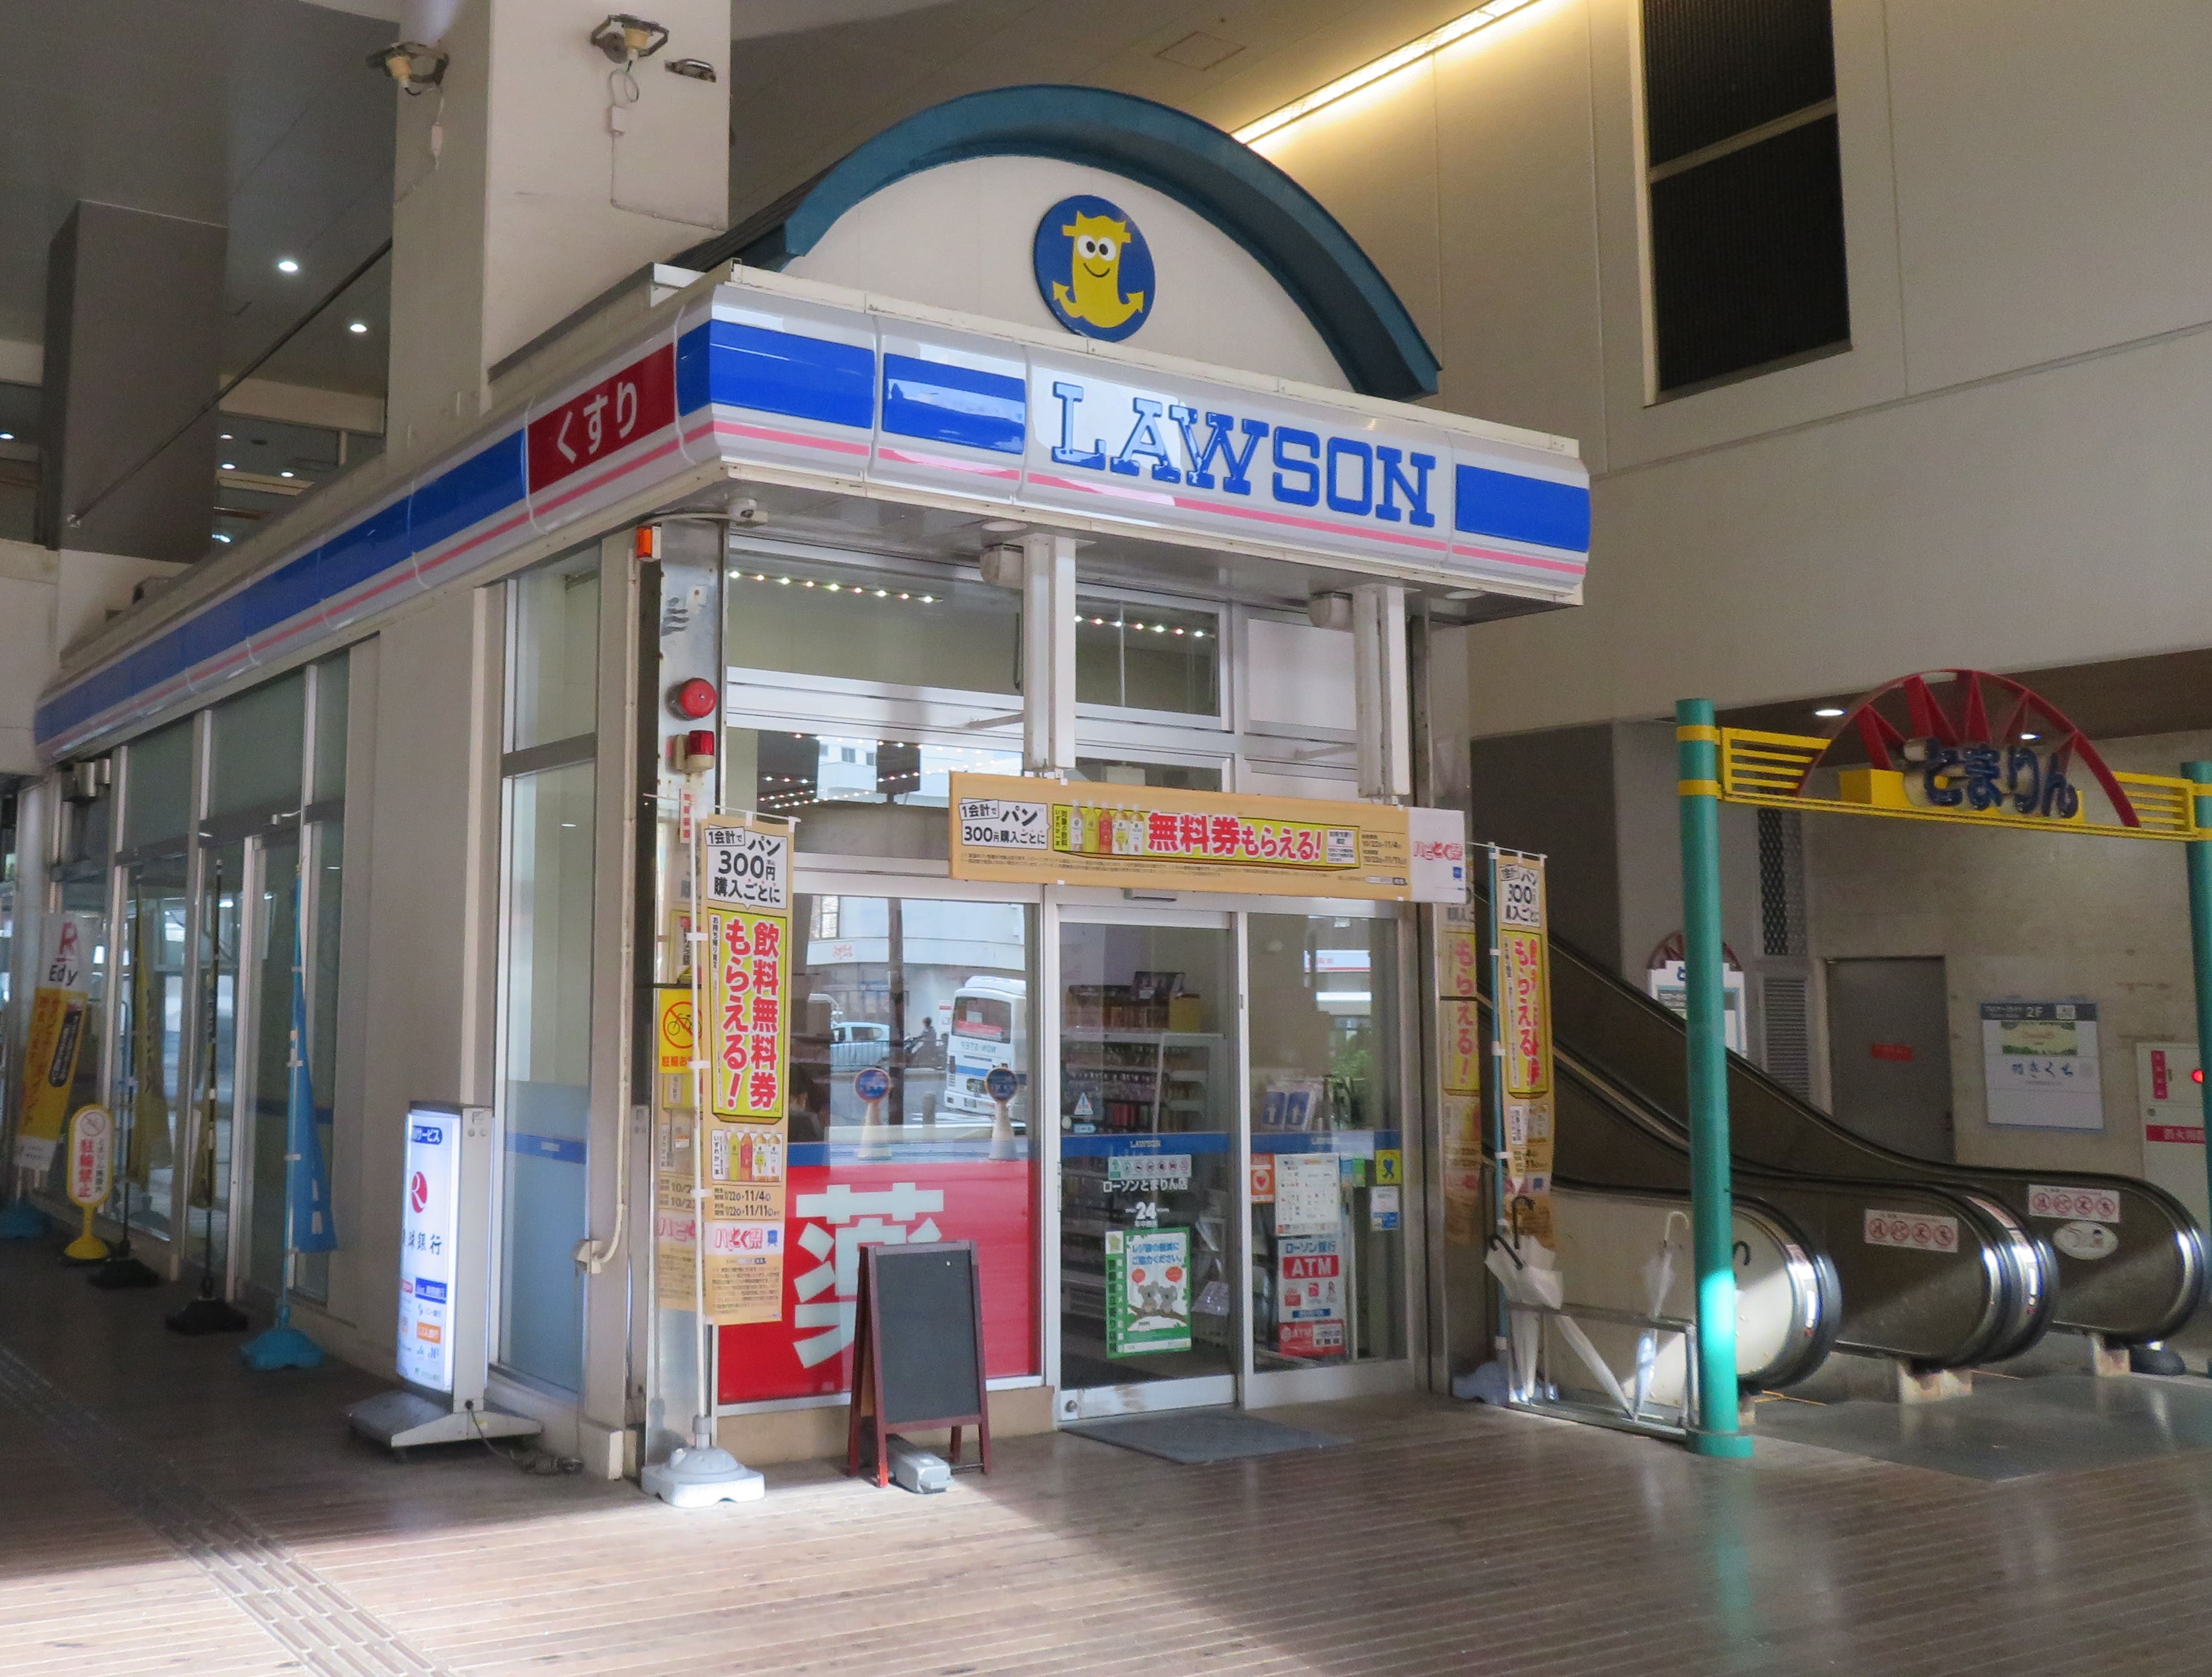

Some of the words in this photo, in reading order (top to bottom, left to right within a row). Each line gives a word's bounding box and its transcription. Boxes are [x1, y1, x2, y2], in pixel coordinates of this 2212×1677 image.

[557, 381, 637, 464] くすり
[1051, 381, 1436, 527] LAWSON
[1922, 736, 2079, 819] とまりん
[962, 803, 997, 818] 1会計で
[1000, 805, 1038, 827] パン
[708, 830, 742, 844] 1会計で
[747, 835, 781, 857] パン
[964, 825, 1046, 845] 300円購入ごとに
[718, 850, 776, 881] 300円
[714, 876, 781, 903] 購入ごとに
[48, 963, 79, 987] Edy
[722, 918, 751, 1108] もらえる!
[750, 921, 780, 1109] 飲料無料券
[2026, 1007, 2043, 1018] 2F
[661, 1056, 693, 1067] 駐輪お
[1103, 1177, 1188, 1193] ローソンとまりん店
[1135, 1201, 1157, 1220] 24
[1285, 1240, 1337, 1254] ローソン銀行
[1291, 1257, 1332, 1277] ATM
